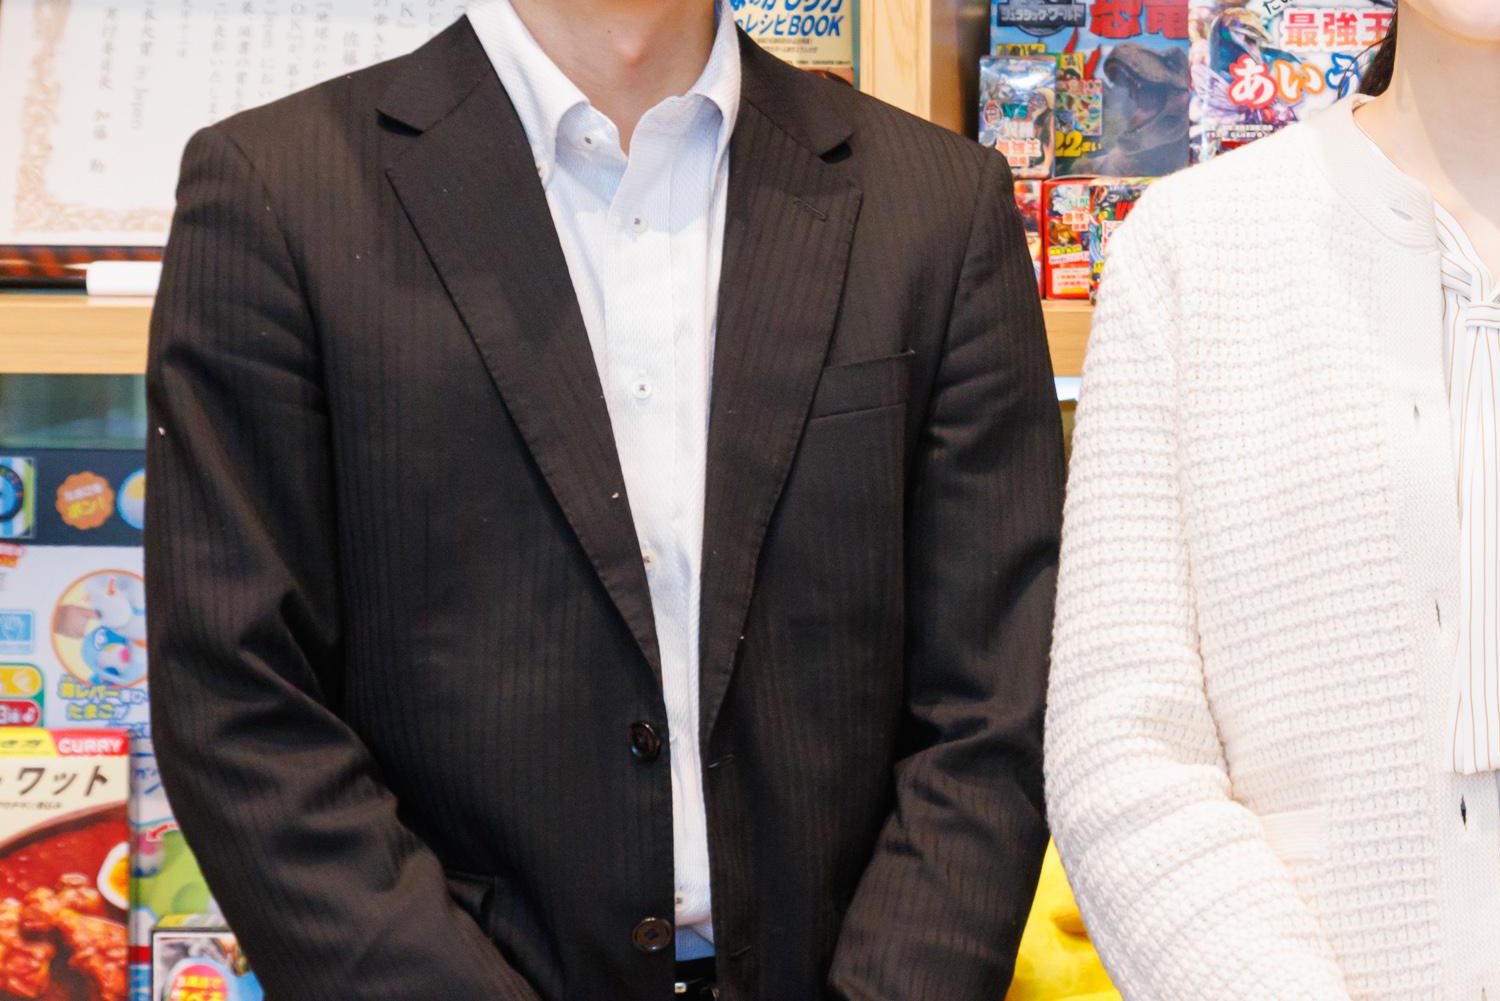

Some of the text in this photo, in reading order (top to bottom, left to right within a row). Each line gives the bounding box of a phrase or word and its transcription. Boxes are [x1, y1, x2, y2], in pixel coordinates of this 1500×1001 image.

[1284, 10, 1394, 48] 最強王
[58, 737, 122, 754] CURRY
